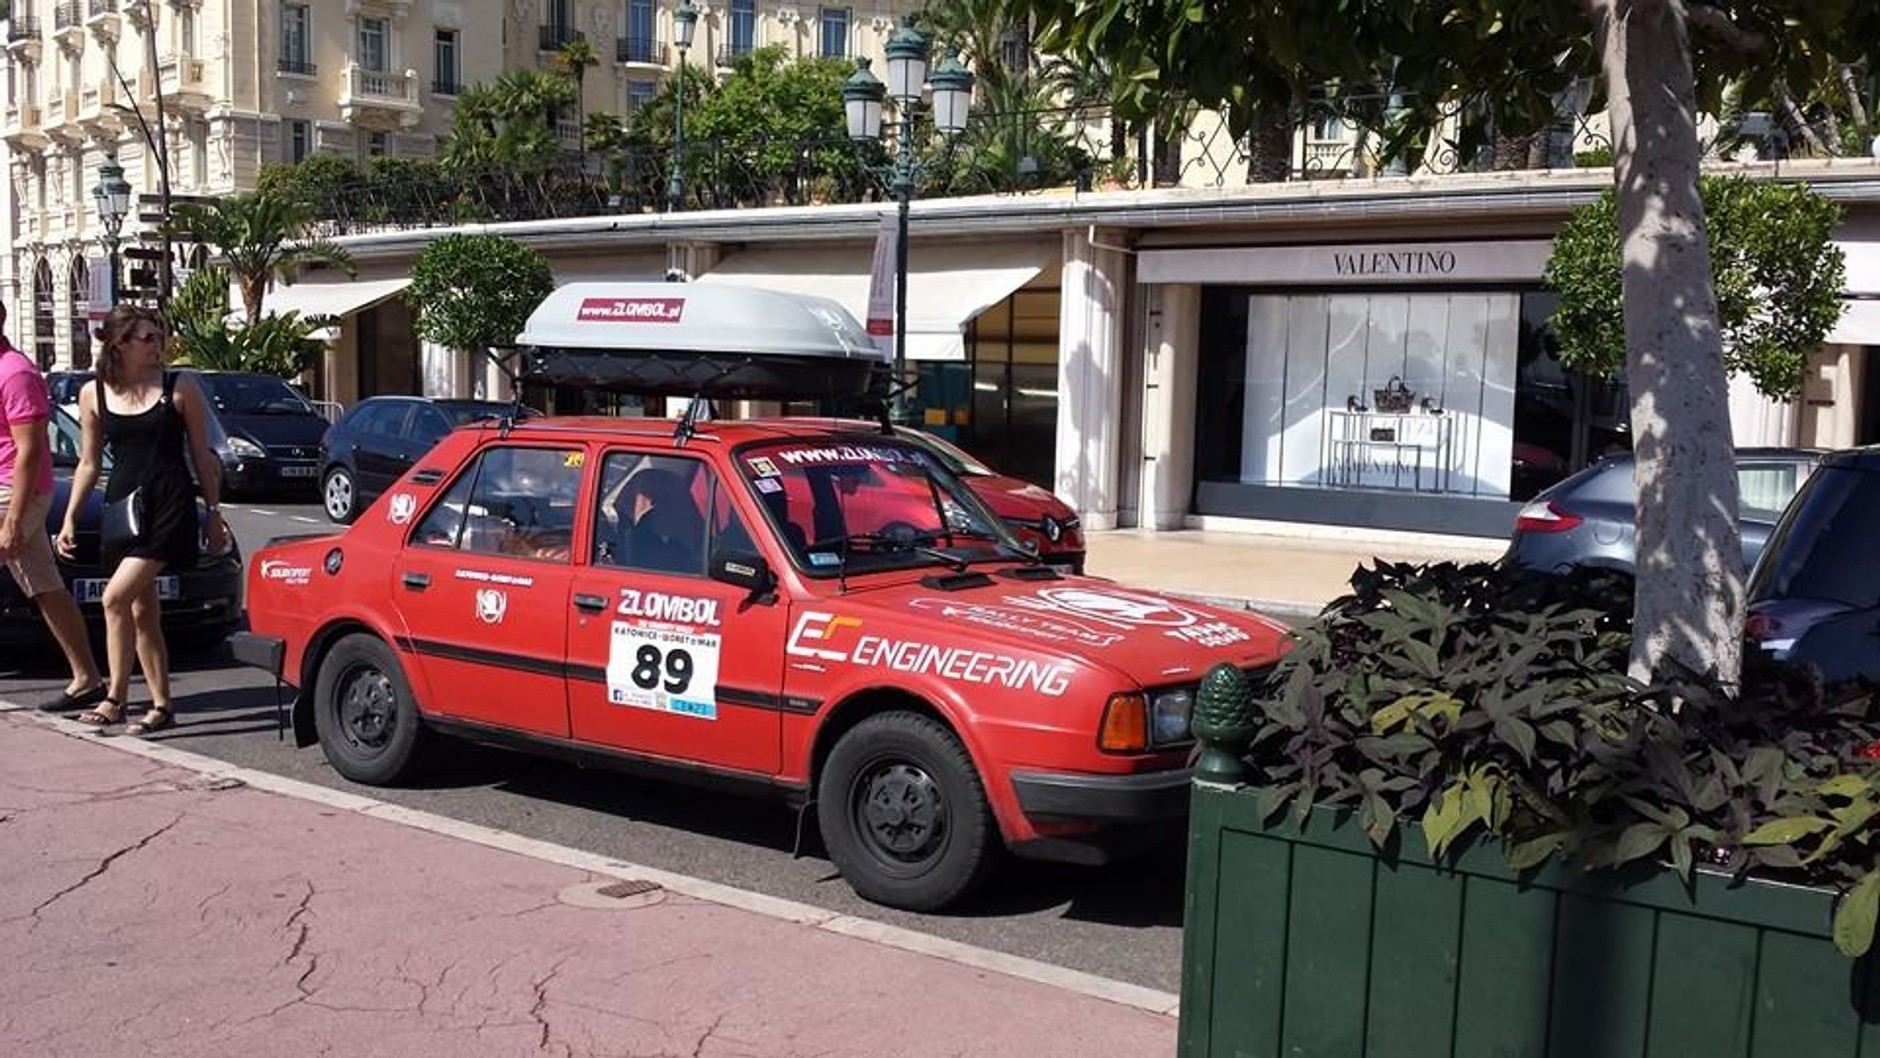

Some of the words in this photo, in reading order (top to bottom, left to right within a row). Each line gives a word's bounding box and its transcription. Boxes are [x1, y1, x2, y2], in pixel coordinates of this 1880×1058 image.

[1333, 250, 1456, 274] VALENTINO
[617, 588, 720, 626] ZLOMBOL
[630, 644, 694, 695] 89
[851, 636, 1076, 696] ENGINEERING
